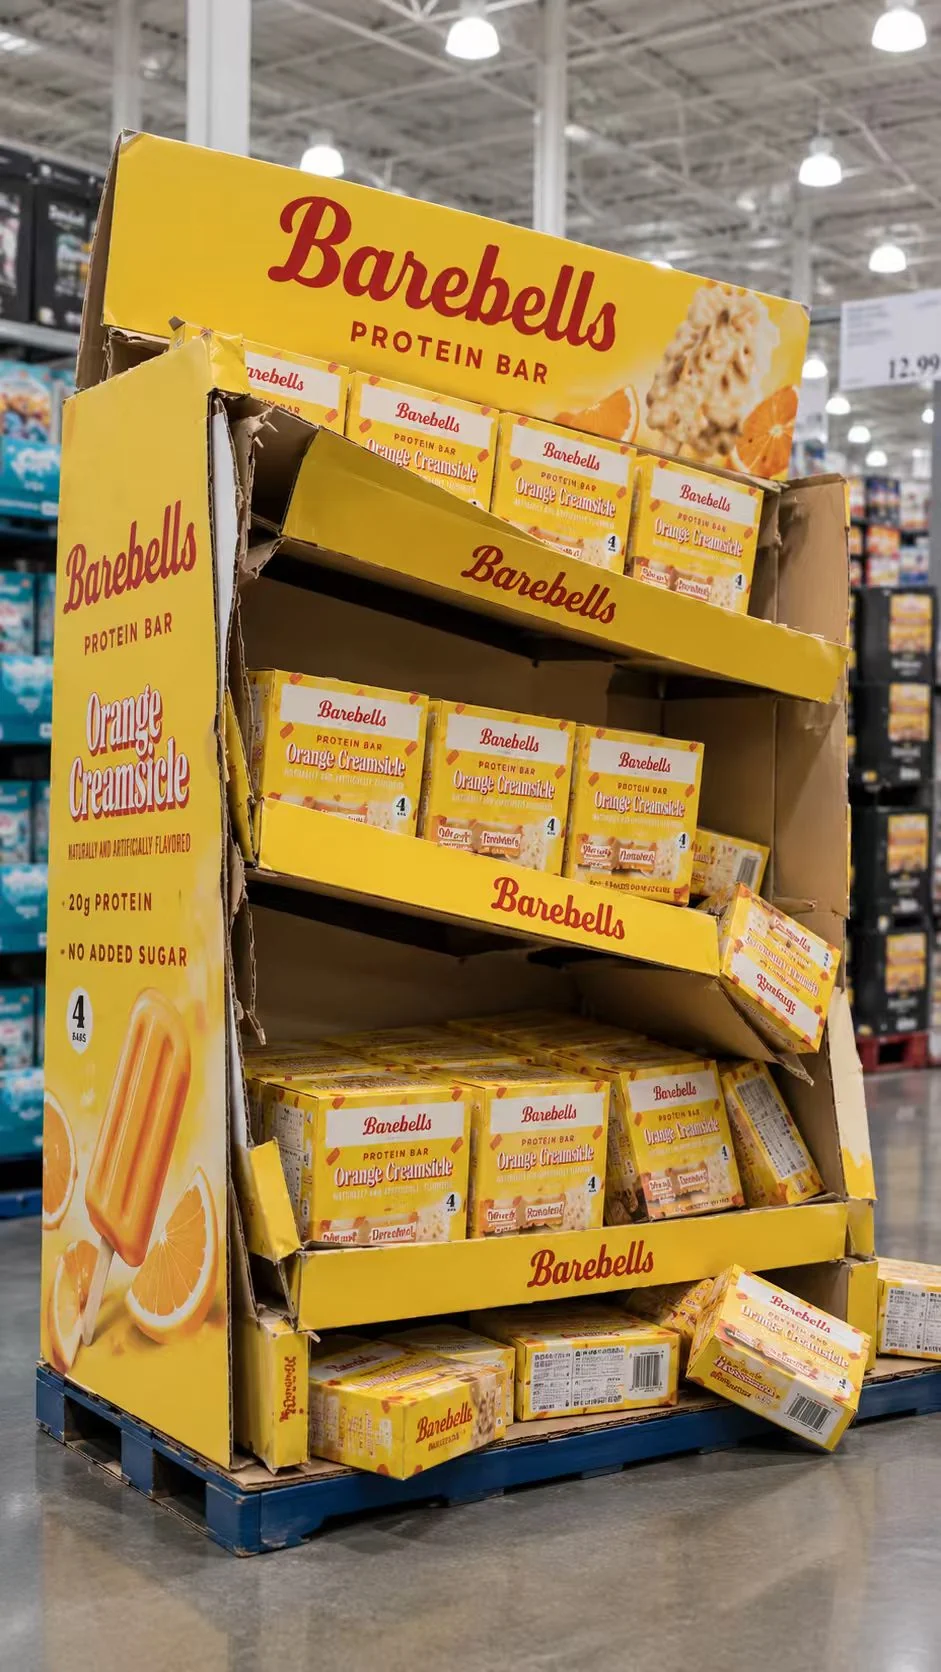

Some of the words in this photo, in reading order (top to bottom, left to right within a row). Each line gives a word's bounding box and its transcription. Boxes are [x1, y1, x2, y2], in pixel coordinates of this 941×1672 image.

[268, 196, 616, 352] Barebells
[350, 320, 483, 369] PROTEIN
[496, 354, 548, 385] BAR
[889, 353, 940, 379] 12.99
[246, 366, 304, 391] arebells
[395, 402, 460, 433] Barebells
[394, 433, 434, 450] PROTEIN
[439, 444, 456, 456] BAR
[543, 441, 600, 471] Barebells
[367, 439, 411, 467] Orange
[414, 450, 478, 483] Creamsicle
[515, 476, 556, 505] Orange
[680, 484, 730, 512] Barebells
[608, 535, 616, 548] 4
[63, 500, 196, 614] Barebells
[461, 545, 616, 624] Barebells
[735, 574, 742, 586] 4
[84, 622, 138, 656] PROTEIN
[144, 612, 172, 639] BAR
[86, 684, 163, 760] Orange
[317, 700, 387, 727] Barebells
[316, 734, 360, 748] PROTEIN
[363, 741, 382, 751] BAR
[480, 728, 539, 752] Barebells
[286, 743, 335, 771] Orange
[338, 750, 406, 778] Creamsicle
[479, 761, 516, 773] PROTEIN
[519, 766, 536, 776] BAR
[618, 752, 671, 773] Barebells
[69, 736, 190, 822] Creamsicle
[453, 770, 494, 795] Orange
[497, 775, 555, 800] Creamsicle
[396, 797, 406, 811] 4
[594, 791, 630, 814] Orange
[547, 818, 555, 832] 4
[68, 841, 98, 860] NATURALLY
[100, 839, 111, 857] AND
[113, 836, 152, 856] ARTIFICIALLY
[155, 833, 191, 853] FLAVORED
[679, 833, 686, 845] 4
[69, 893, 91, 916] 20g
[95, 892, 152, 911] PROTEIN
[491, 877, 625, 940] Barebells
[68, 943, 85, 960] NO
[89, 944, 133, 963] ADDED
[139, 945, 187, 967] SUGAR
[72, 995, 85, 1028] 4
[653, 1081, 697, 1101] Barebells
[362, 1113, 432, 1136] Barebells
[521, 1104, 576, 1123] Barebells
[521, 1136, 556, 1146] PROTEIN
[559, 1135, 575, 1144] BAR
[721, 1145, 728, 1157] 4
[363, 1149, 405, 1161] PROTEIN
[410, 1147, 429, 1156] BAR
[497, 1151, 536, 1171] Orange
[334, 1165, 383, 1188] Orange
[385, 1156, 454, 1181] Creamsicle
[588, 1176, 596, 1189] 4
[446, 1194, 455, 1207] 4
[527, 1240, 654, 1288] Barebells
